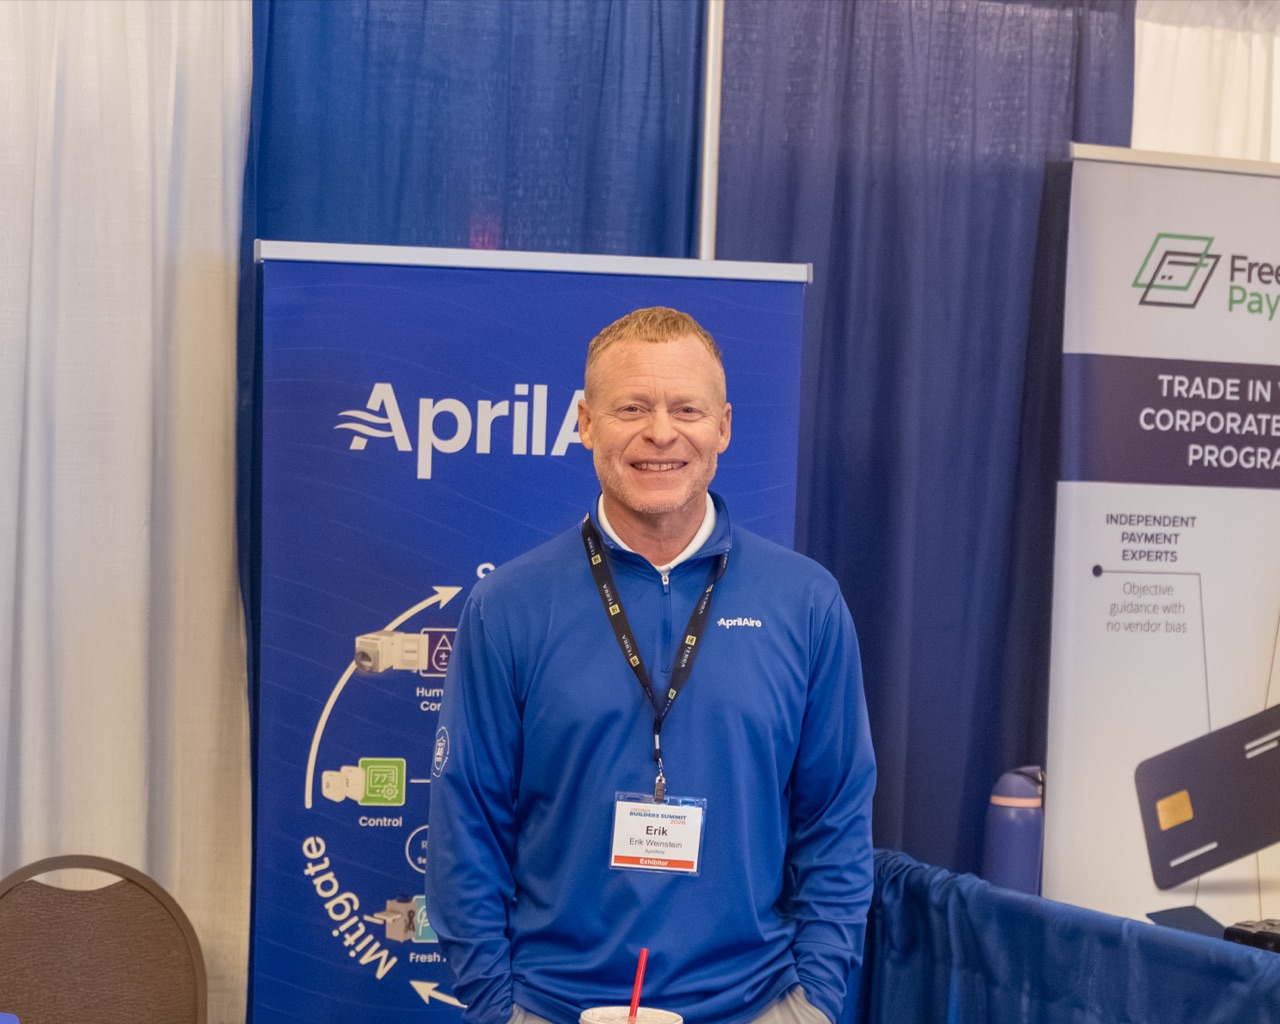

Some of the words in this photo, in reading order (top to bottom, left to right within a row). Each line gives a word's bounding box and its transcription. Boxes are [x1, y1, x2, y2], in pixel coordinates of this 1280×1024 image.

[1158, 373, 1241, 401] TRADE
[1247, 379, 1271, 402] IN
[1105, 513, 1198, 528] INDEPENDENT
[1120, 531, 1181, 546] PAYMENT
[1121, 549, 1179, 563] EXPERTS
[1122, 582, 1175, 599] Objective
[1109, 601, 1160, 617] guidance
[1162, 602, 1186, 615] with
[716, 617, 762, 629] AprilAire
[1106, 621, 1121, 633] no
[1123, 620, 1162, 633] vendor
[1165, 620, 1188, 634] bias
[358, 816, 403, 828] Control
[629, 811, 660, 819] BUILDERS
[645, 825, 668, 837] Erik
[629, 837, 644, 846] Erik
[645, 839, 683, 849] Weinstein
[639, 858, 668, 867] Exhibitor
[302, 836, 399, 981] Mitigate
[409, 952, 441, 963] Fresh
